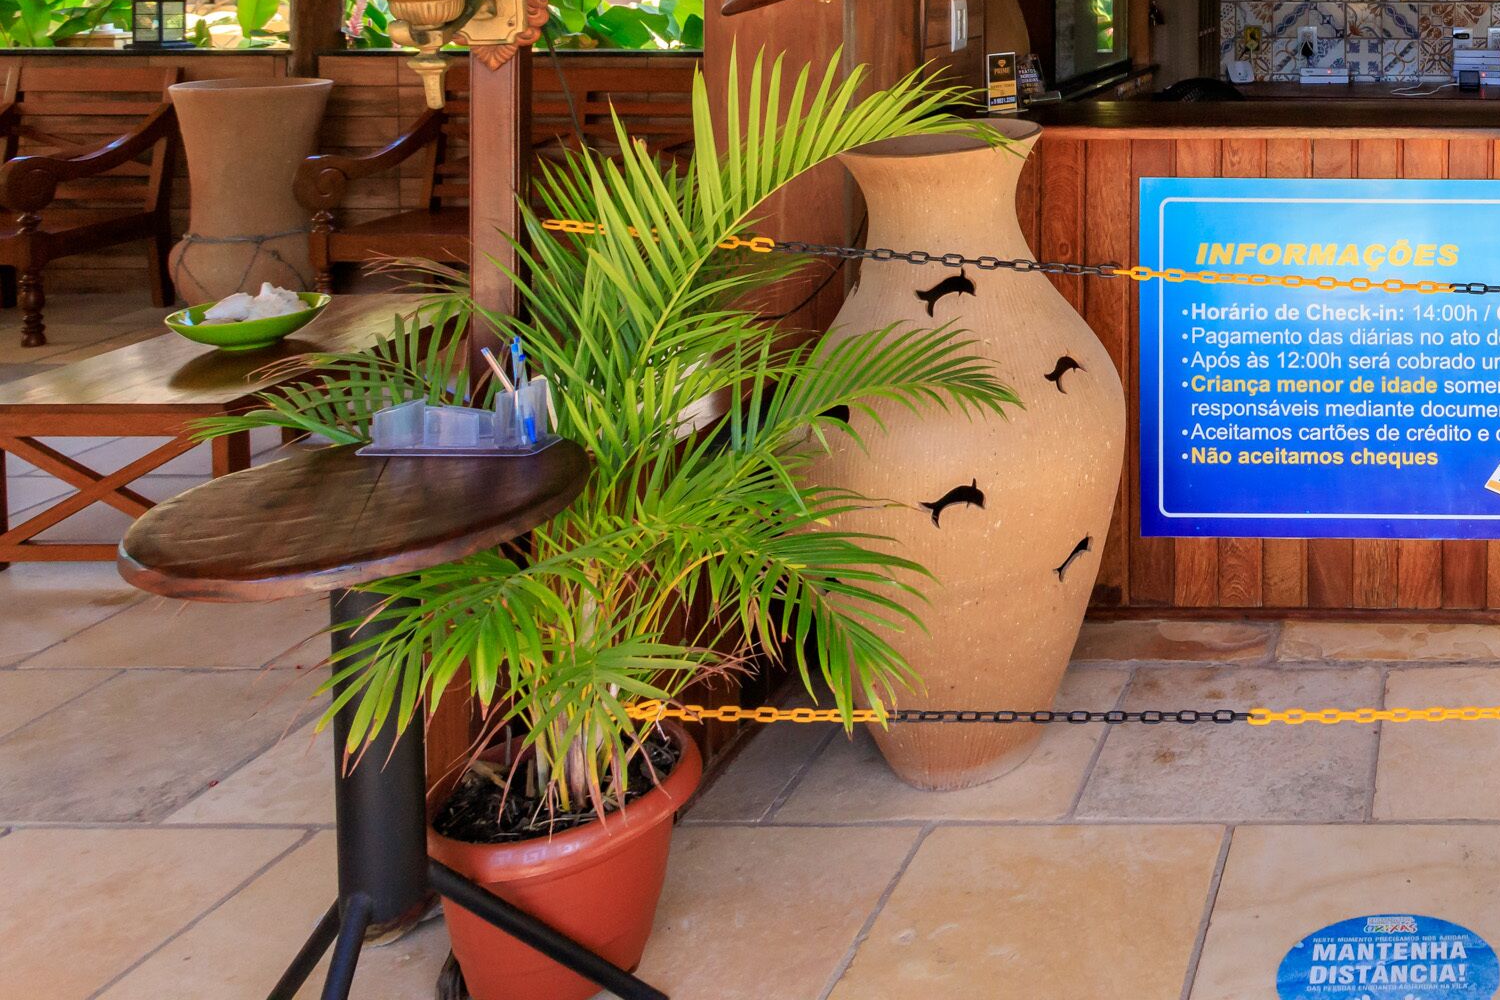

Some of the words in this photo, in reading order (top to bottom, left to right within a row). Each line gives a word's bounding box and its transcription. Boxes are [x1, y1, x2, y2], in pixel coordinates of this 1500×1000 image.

[1195, 240, 1460, 271] INFORMAÇÕES
[1191, 303, 1268, 320] Horário
[1274, 304, 1300, 321] de
[1306, 303, 1404, 321] Check-in:
[1413, 304, 1478, 322] 14:00h
[1191, 328, 1302, 348] Pagamento
[1308, 328, 1343, 346] das
[1350, 328, 1414, 346] diárias
[1420, 332, 1444, 346] no
[1450, 330, 1481, 346] ato
[1190, 352, 1240, 371] Após
[1246, 352, 1270, 368] às
[1277, 352, 1342, 368] 12:00h
[1348, 352, 1390, 369] será
[1396, 352, 1476, 370] cobrado
[1191, 374, 1270, 396] Criança
[1277, 379, 1344, 393] menor
[1350, 376, 1374, 394] de
[1381, 376, 1438, 394] idade
[1191, 400, 1318, 420] responsáveis
[1326, 400, 1414, 418] mediante
[1190, 423, 1292, 441] Aceitamos
[1298, 424, 1370, 442] cartões
[1376, 424, 1400, 442] de
[1406, 424, 1472, 442] crédito
[1478, 428, 1490, 442] e
[1191, 447, 1232, 465] Não
[1238, 448, 1344, 466] aceitamos
[1351, 447, 1438, 468] cheques
[1312, 942, 1467, 960] MANTENHA
[1309, 961, 1466, 984] DISTÂNCIA!
